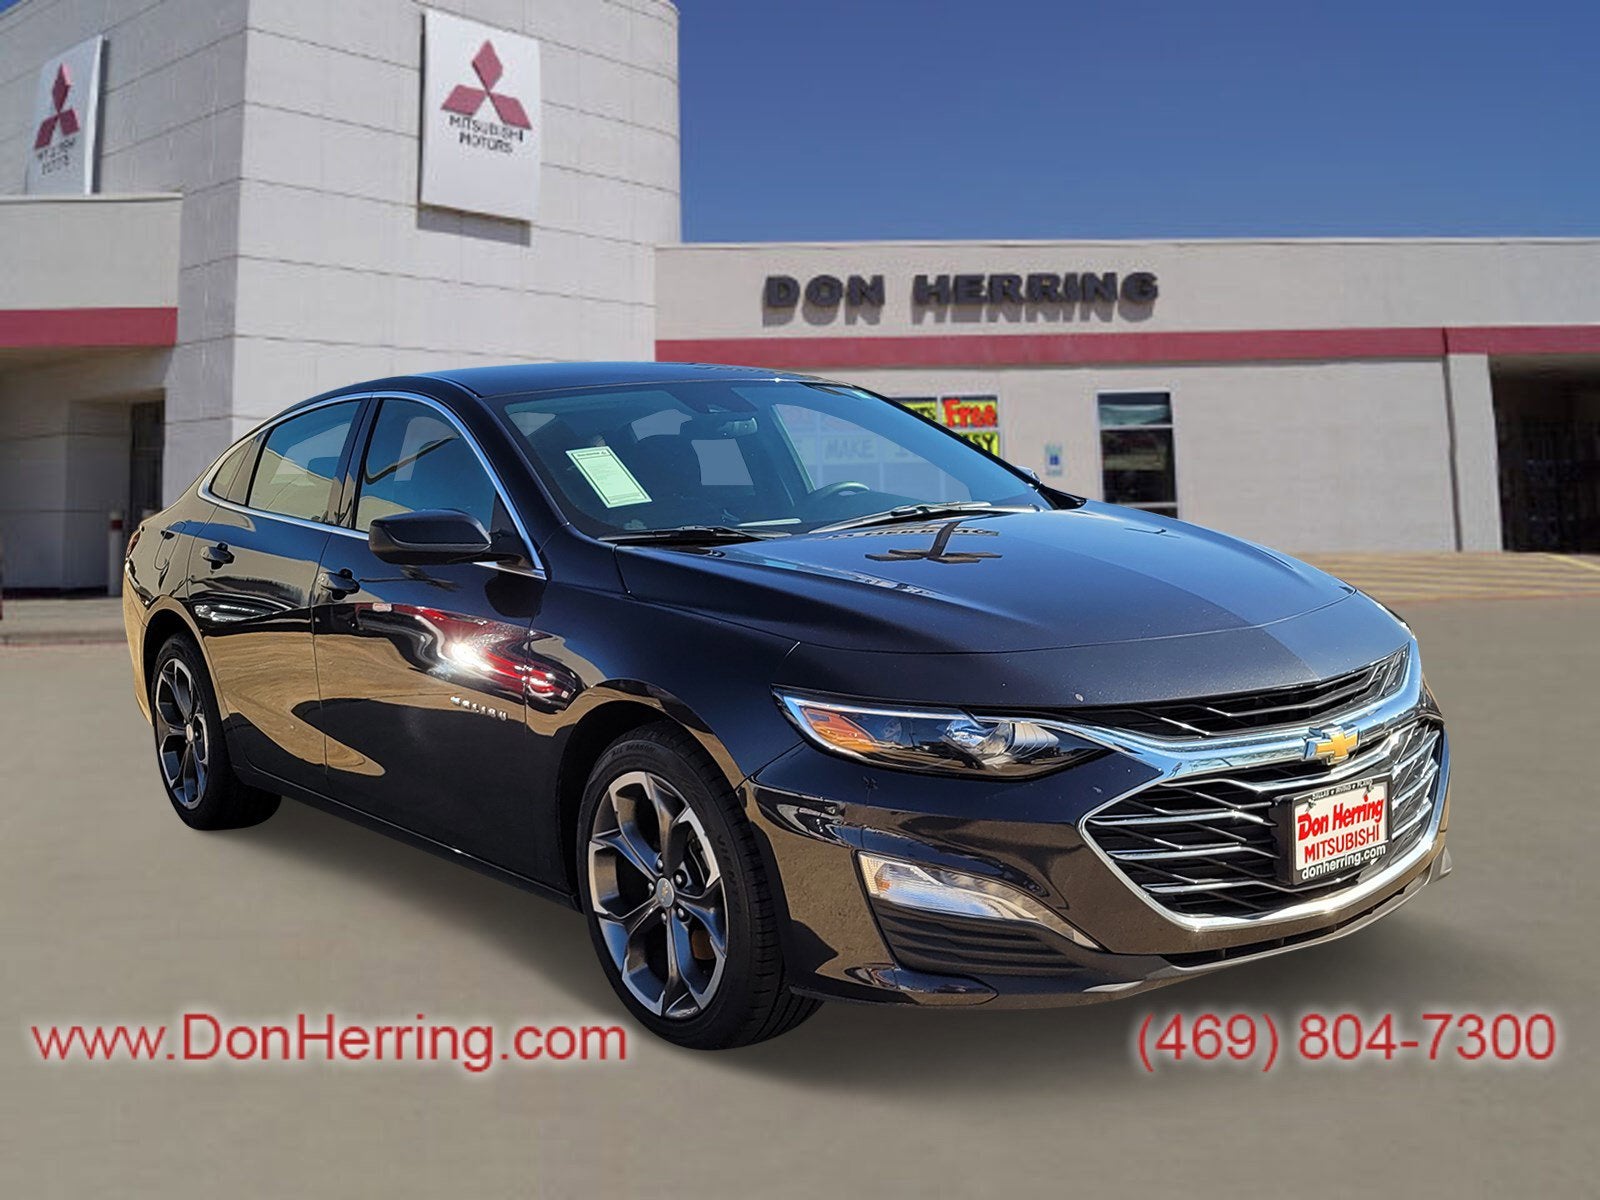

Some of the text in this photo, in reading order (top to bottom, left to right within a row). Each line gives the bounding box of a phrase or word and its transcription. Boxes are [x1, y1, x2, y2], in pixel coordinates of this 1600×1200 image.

[460, 132, 513, 153] MOTORS
[764, 271, 1159, 308] DON HERRING
[942, 398, 998, 428] Free
[825, 439, 875, 459] MAKE
[1297, 794, 1384, 841] Don Herring
[1304, 824, 1380, 863] MITSUBISHI
[1302, 844, 1386, 880] donherring.com
